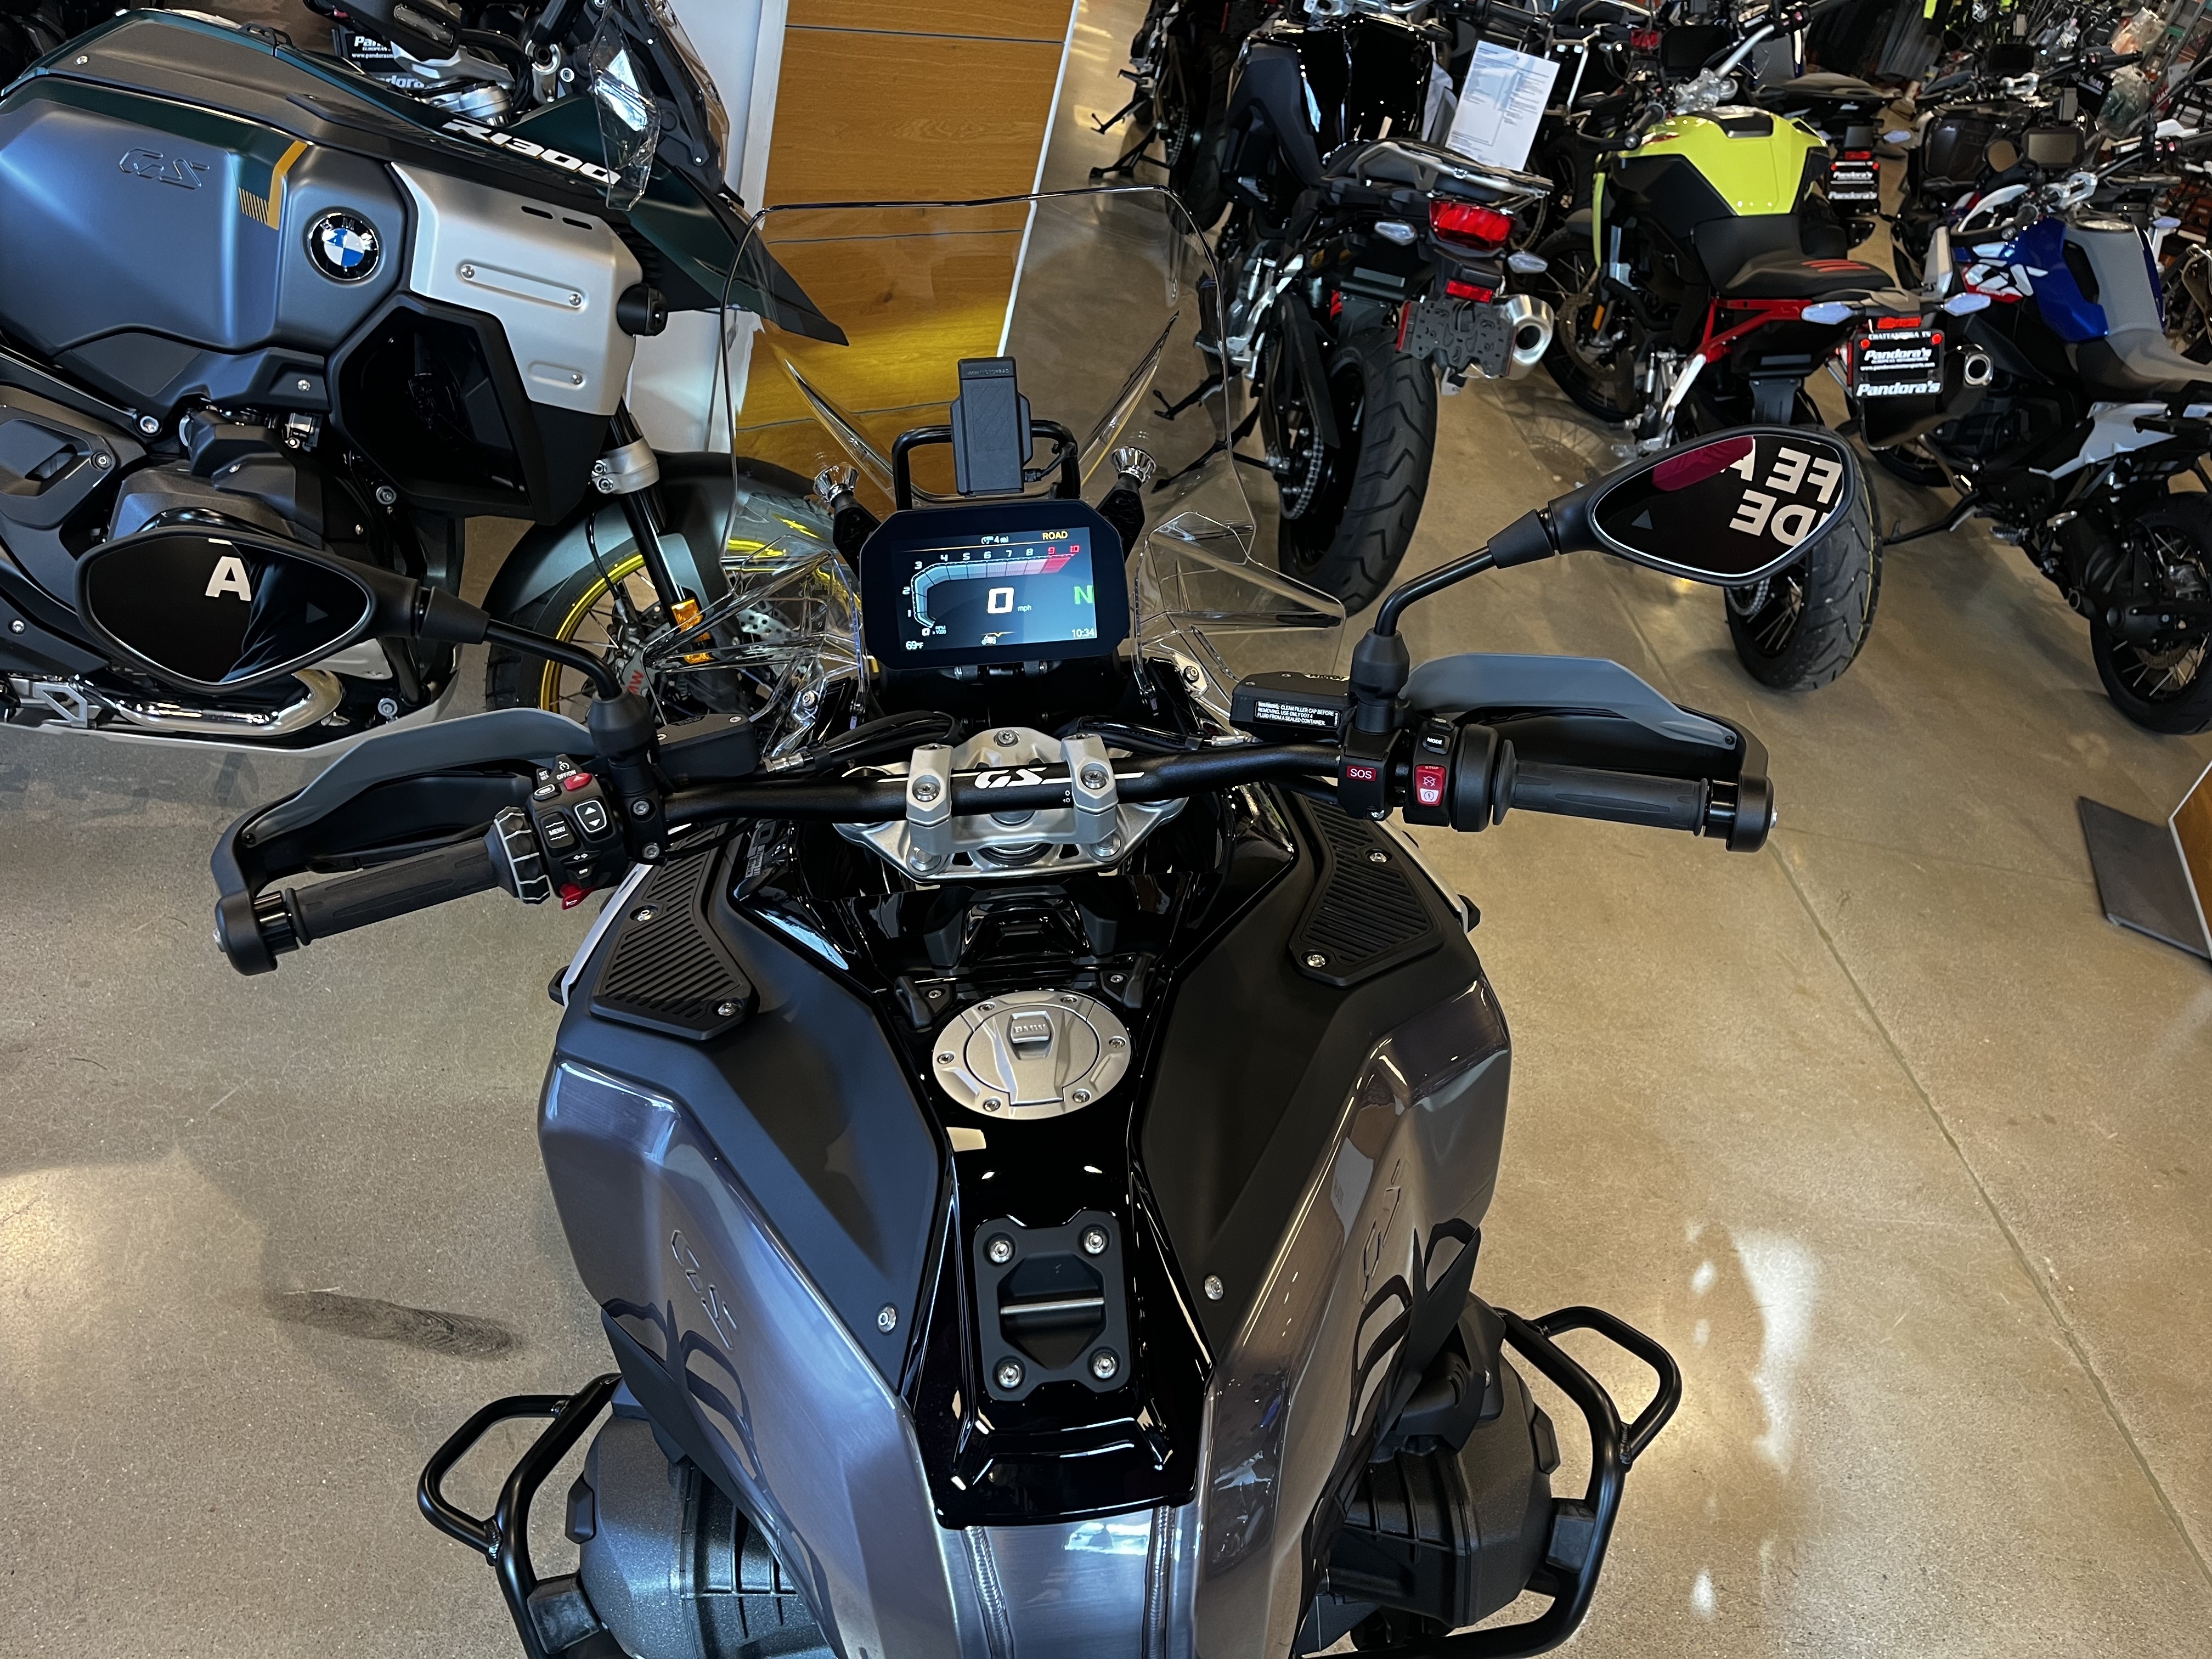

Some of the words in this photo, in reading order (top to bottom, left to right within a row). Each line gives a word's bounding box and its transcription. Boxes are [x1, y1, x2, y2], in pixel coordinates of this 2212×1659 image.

[1864, 347, 1932, 361] Pandora's
[1856, 380, 1941, 397] Pandora's
[1042, 531, 1069, 540] ROAD
[914, 561, 923, 569] 3
[962, 552, 970, 561] 5
[984, 551, 991, 559] 6
[1025, 548, 1034, 556] 8
[1048, 546, 1056, 555] 9
[1070, 545, 1080, 553] 10
[902, 586, 911, 595] 2
[1074, 585, 1094, 605] N
[988, 587, 1014, 614] 0
[922, 628, 930, 636] 0
[1071, 628, 1094, 637] 10:34
[1427, 737, 1443, 745] MODE
[974, 767, 1043, 789] GS
[1350, 768, 1372, 780] SOS
[549, 826, 566, 836] MENU
[1014, 1024, 1046, 1033] BMW
